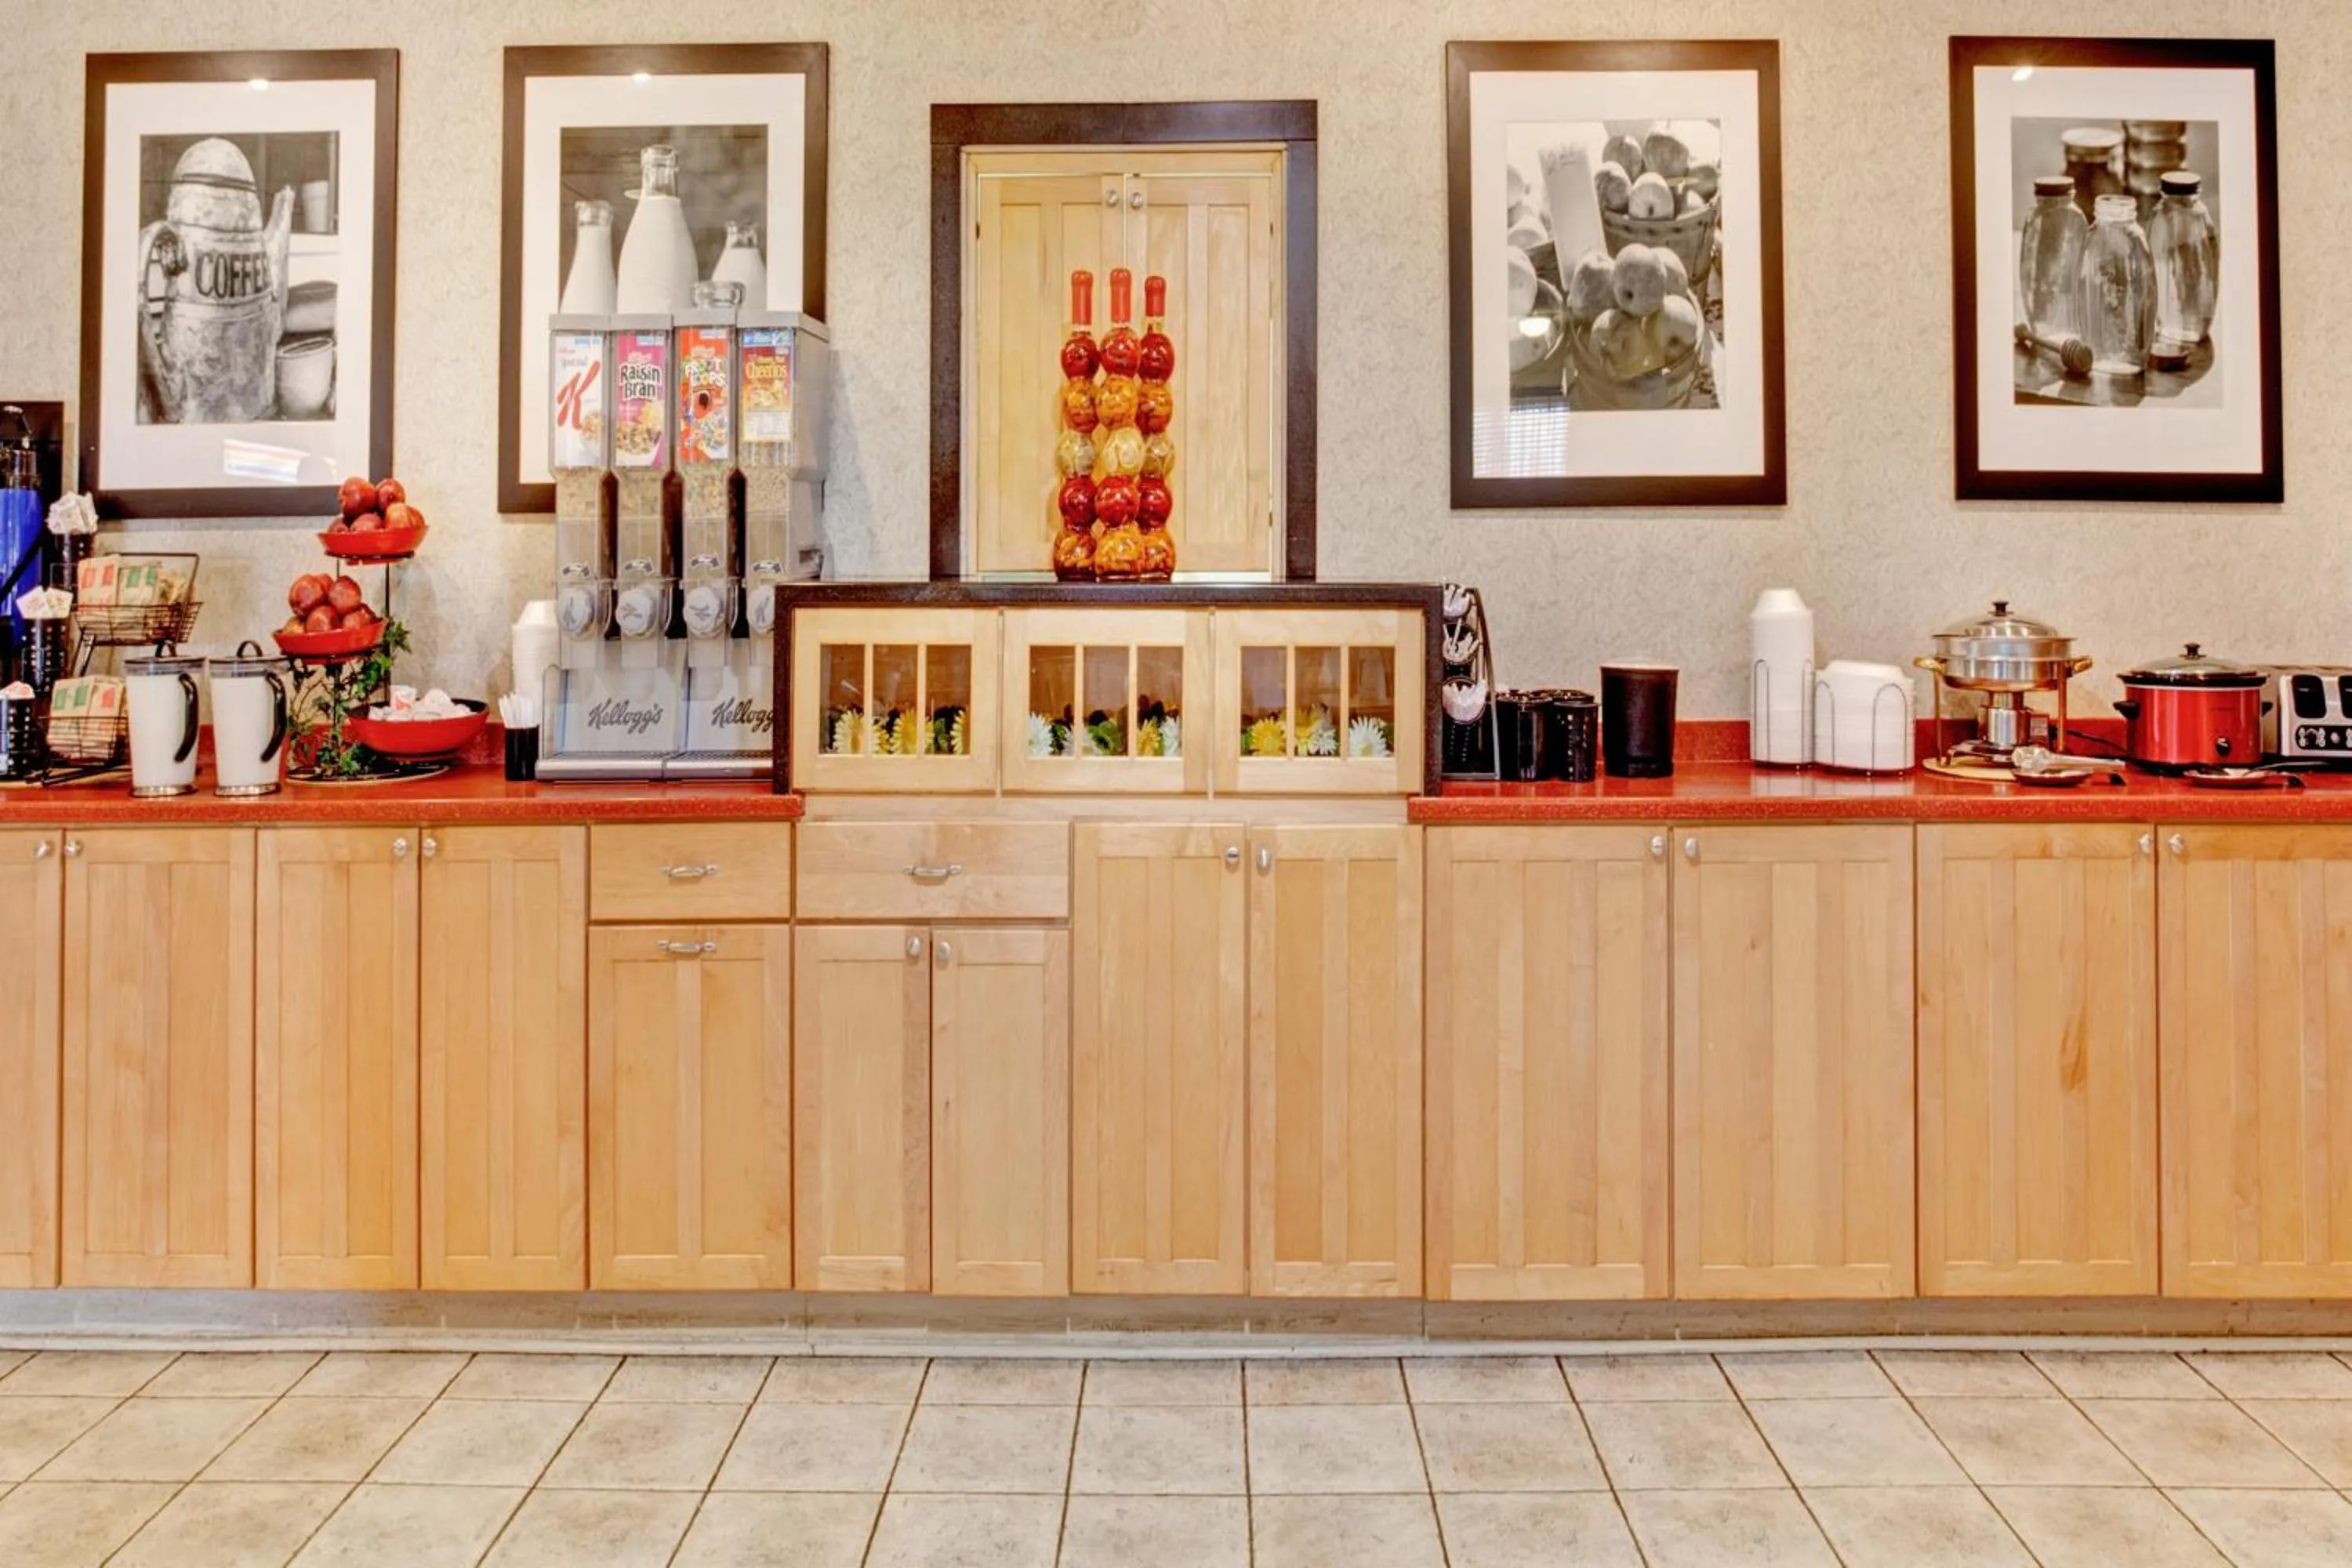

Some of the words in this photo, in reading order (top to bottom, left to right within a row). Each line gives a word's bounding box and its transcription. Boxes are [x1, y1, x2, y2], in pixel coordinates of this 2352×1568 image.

[620, 363, 660, 383] Raisin
[624, 382, 655, 398] Bran
[588, 698, 664, 735] Kellogg's
[710, 696, 774, 733] Kellogg
